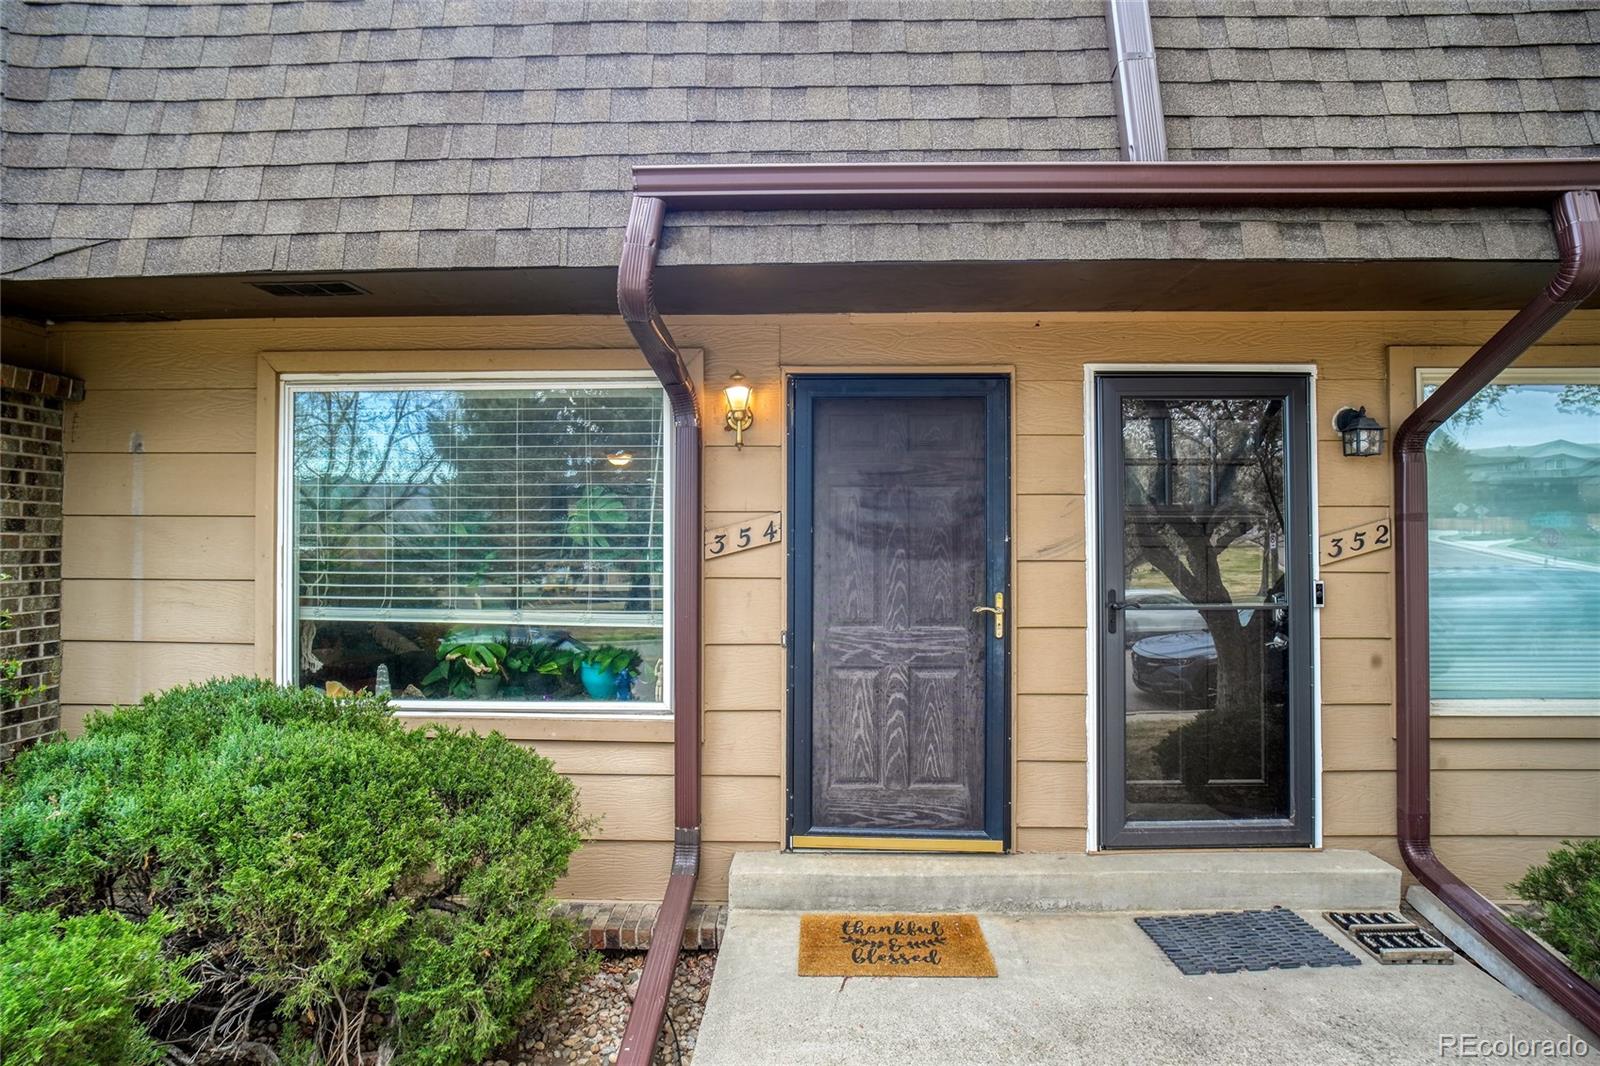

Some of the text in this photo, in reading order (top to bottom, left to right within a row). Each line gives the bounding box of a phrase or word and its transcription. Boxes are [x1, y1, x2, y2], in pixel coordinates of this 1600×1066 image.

[709, 520, 778, 554] 354
[1328, 524, 1389, 558] 352
[841, 920, 945, 936] thankful
[889, 937, 903, 952] &
[851, 947, 942, 965] blessed
